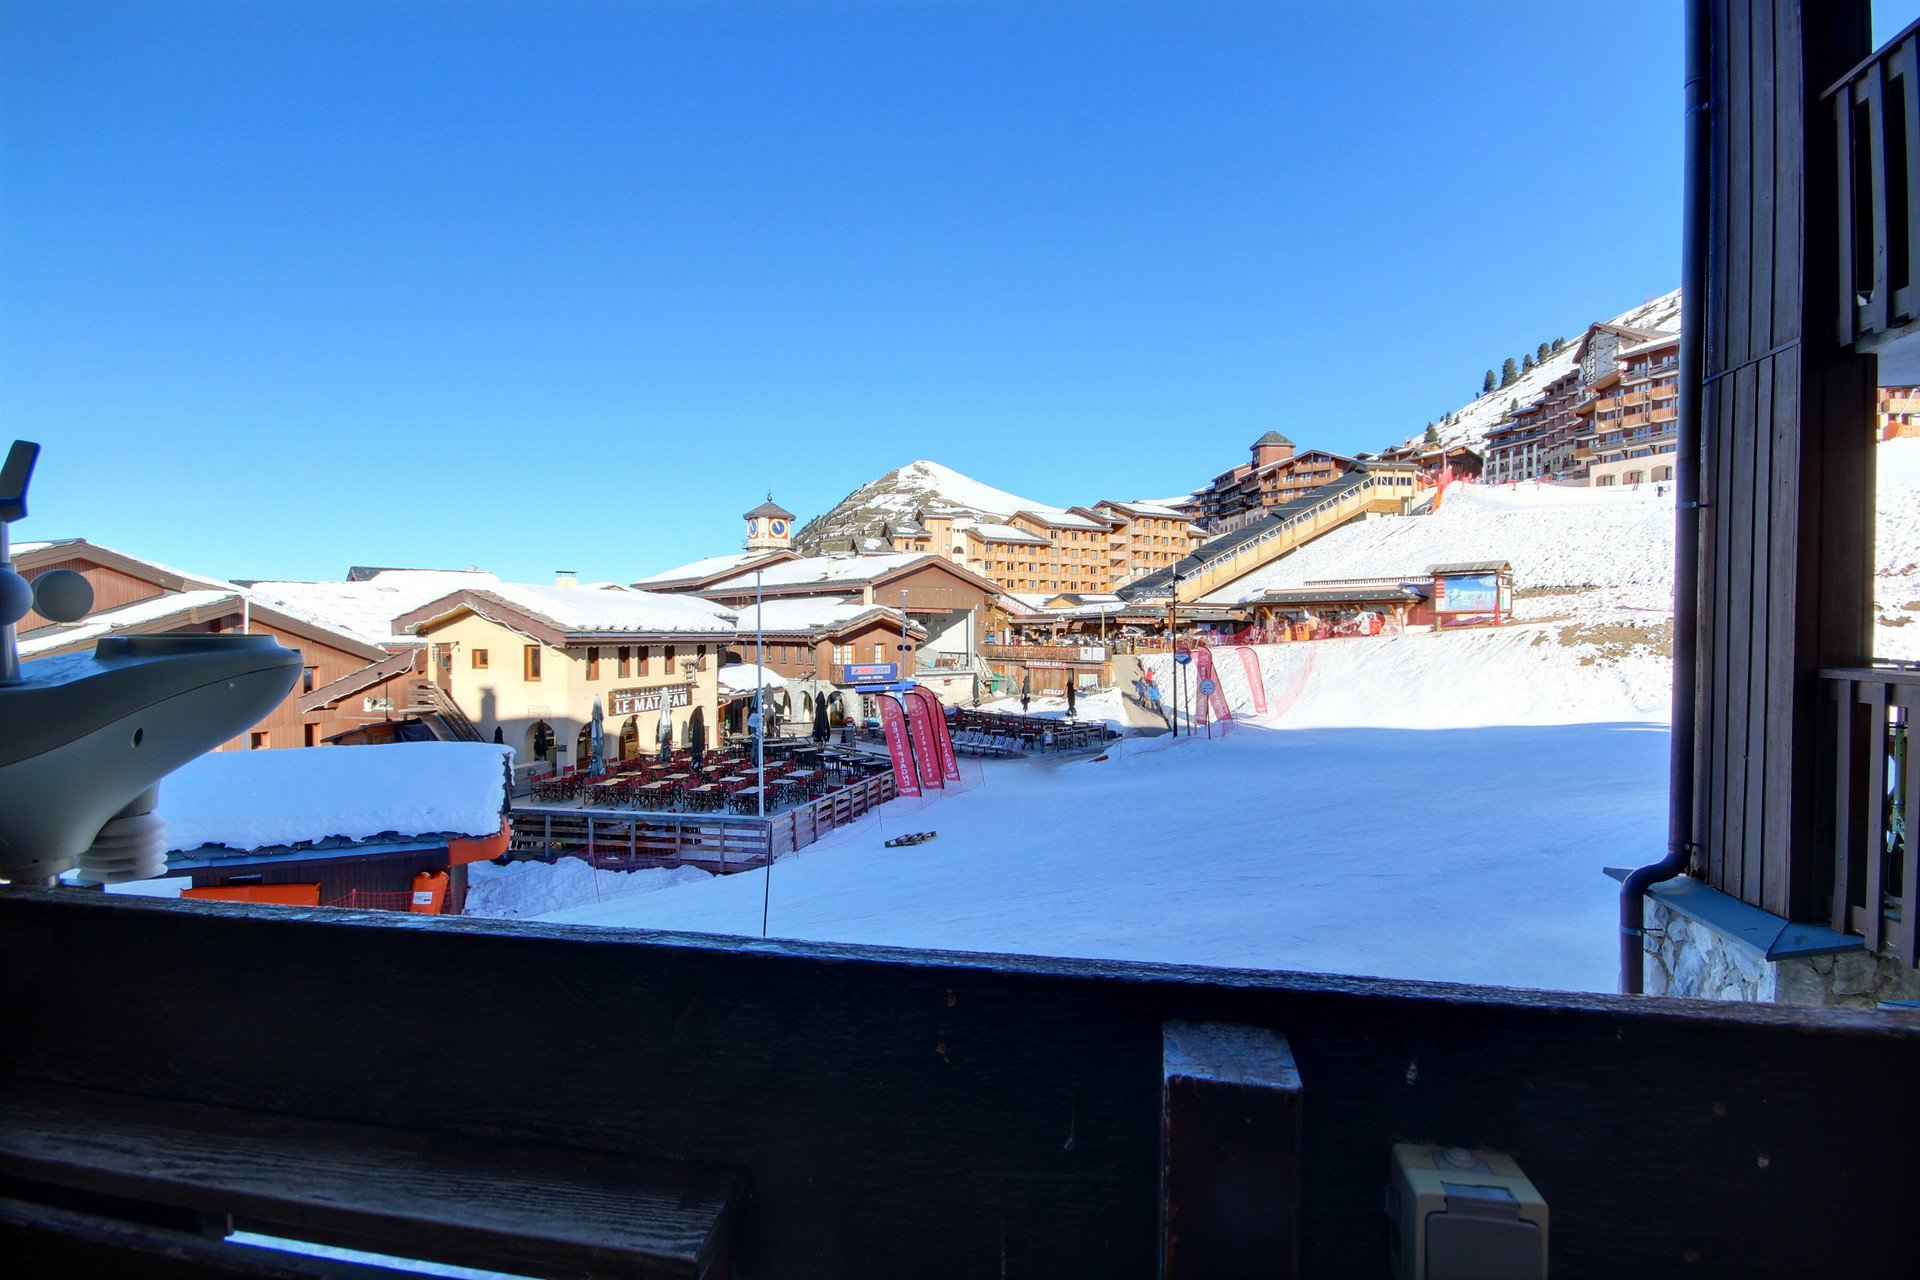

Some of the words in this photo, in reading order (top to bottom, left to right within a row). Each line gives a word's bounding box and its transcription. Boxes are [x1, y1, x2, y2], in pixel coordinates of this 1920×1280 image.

[640, 685, 687, 696] RESTARANT
[616, 700, 630, 714] LE
[634, 693, 687, 712] MATFAN
